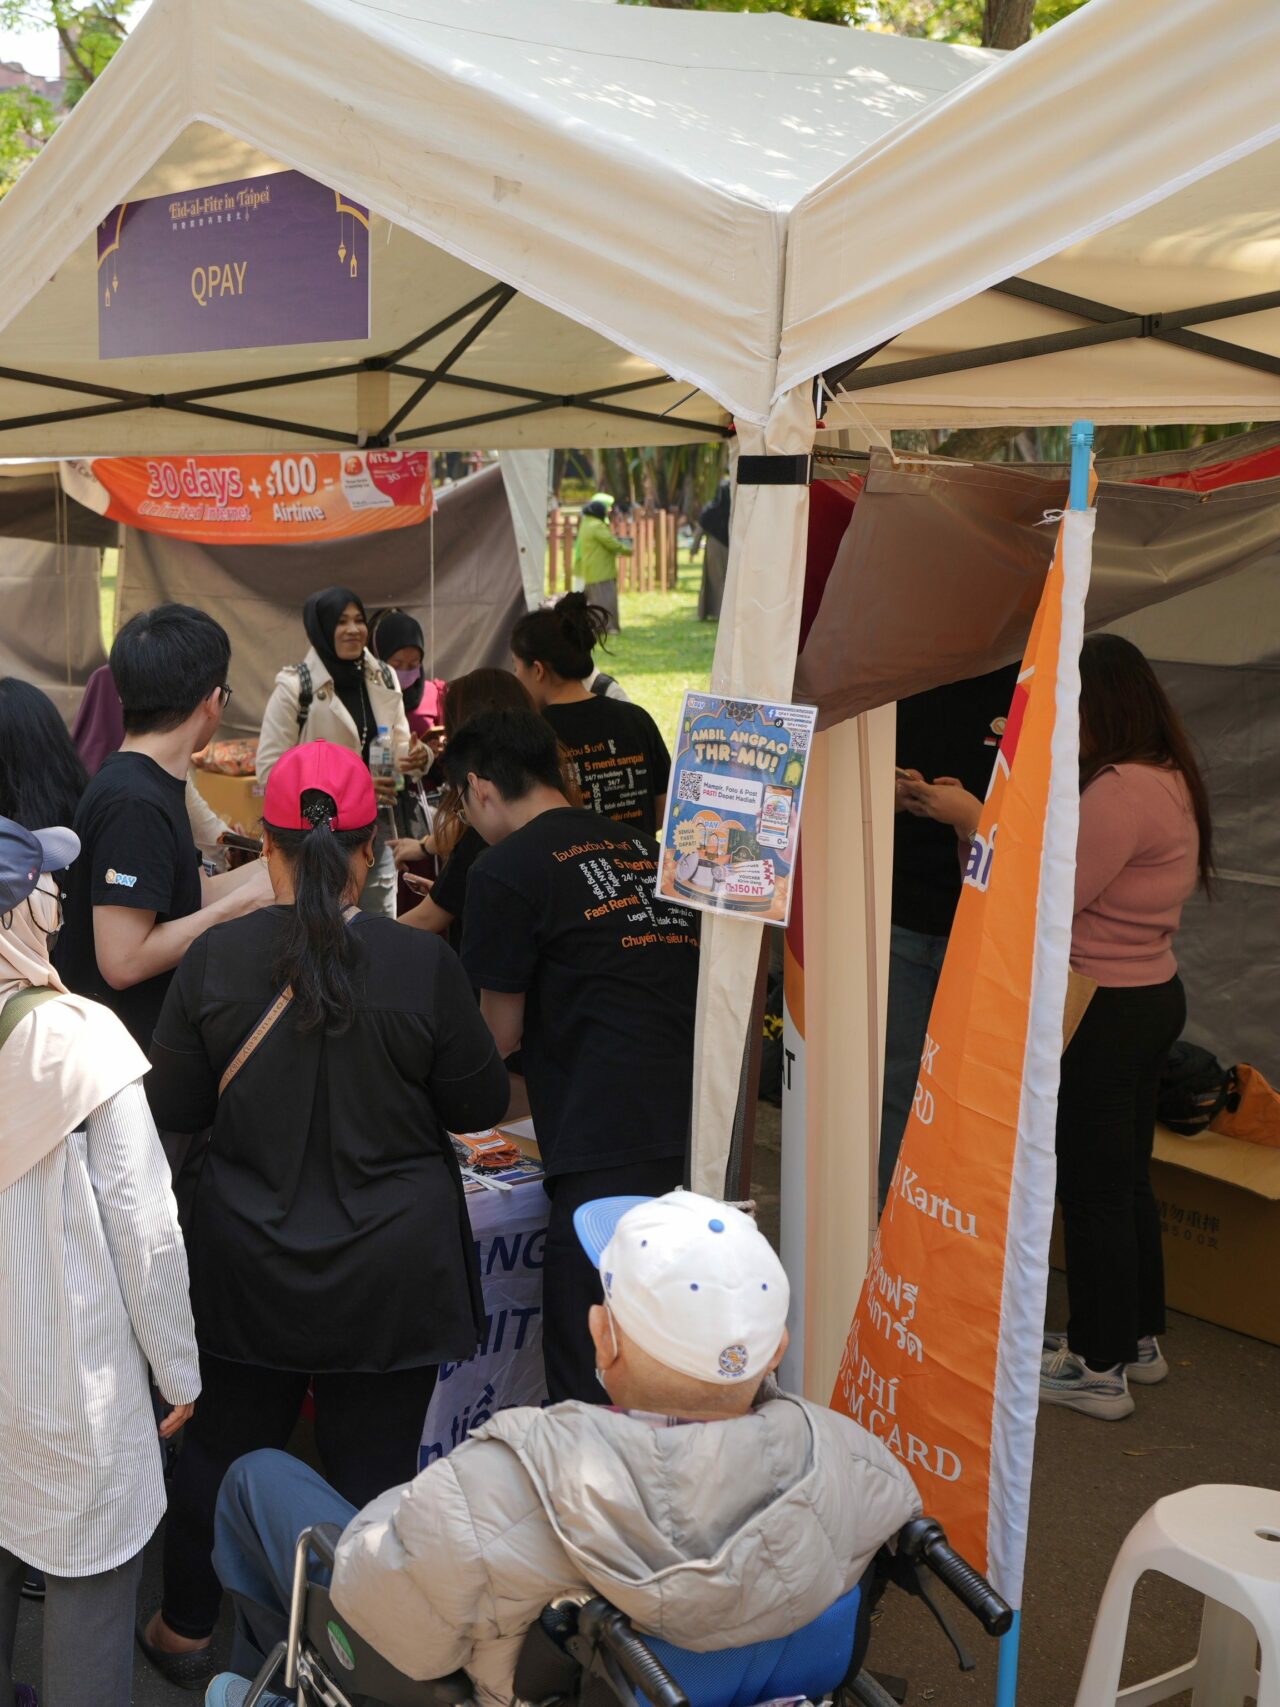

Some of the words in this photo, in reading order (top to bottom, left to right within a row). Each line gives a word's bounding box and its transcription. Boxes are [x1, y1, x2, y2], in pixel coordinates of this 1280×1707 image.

[225, 193, 235, 210] in
[237, 185, 270, 209] Taipei
[191, 262, 247, 306] QPAY
[147, 461, 180, 499] 30
[182, 457, 243, 507] days
[266, 456, 317, 497] $100
[272, 502, 326, 523] Airtime
[692, 728, 727, 741] AMBIL
[730, 730, 788, 755] ANGPAO
[592, 757, 616, 770] menit
[695, 743, 779, 773] THR-MU!
[613, 858, 624, 869] 5
[584, 903, 609, 920] Fast
[608, 894, 641, 911] Remit
[897, 1164, 979, 1239] Kartu
[858, 1355, 901, 1416] PHÍ
[868, 1408, 963, 1483] CARD
